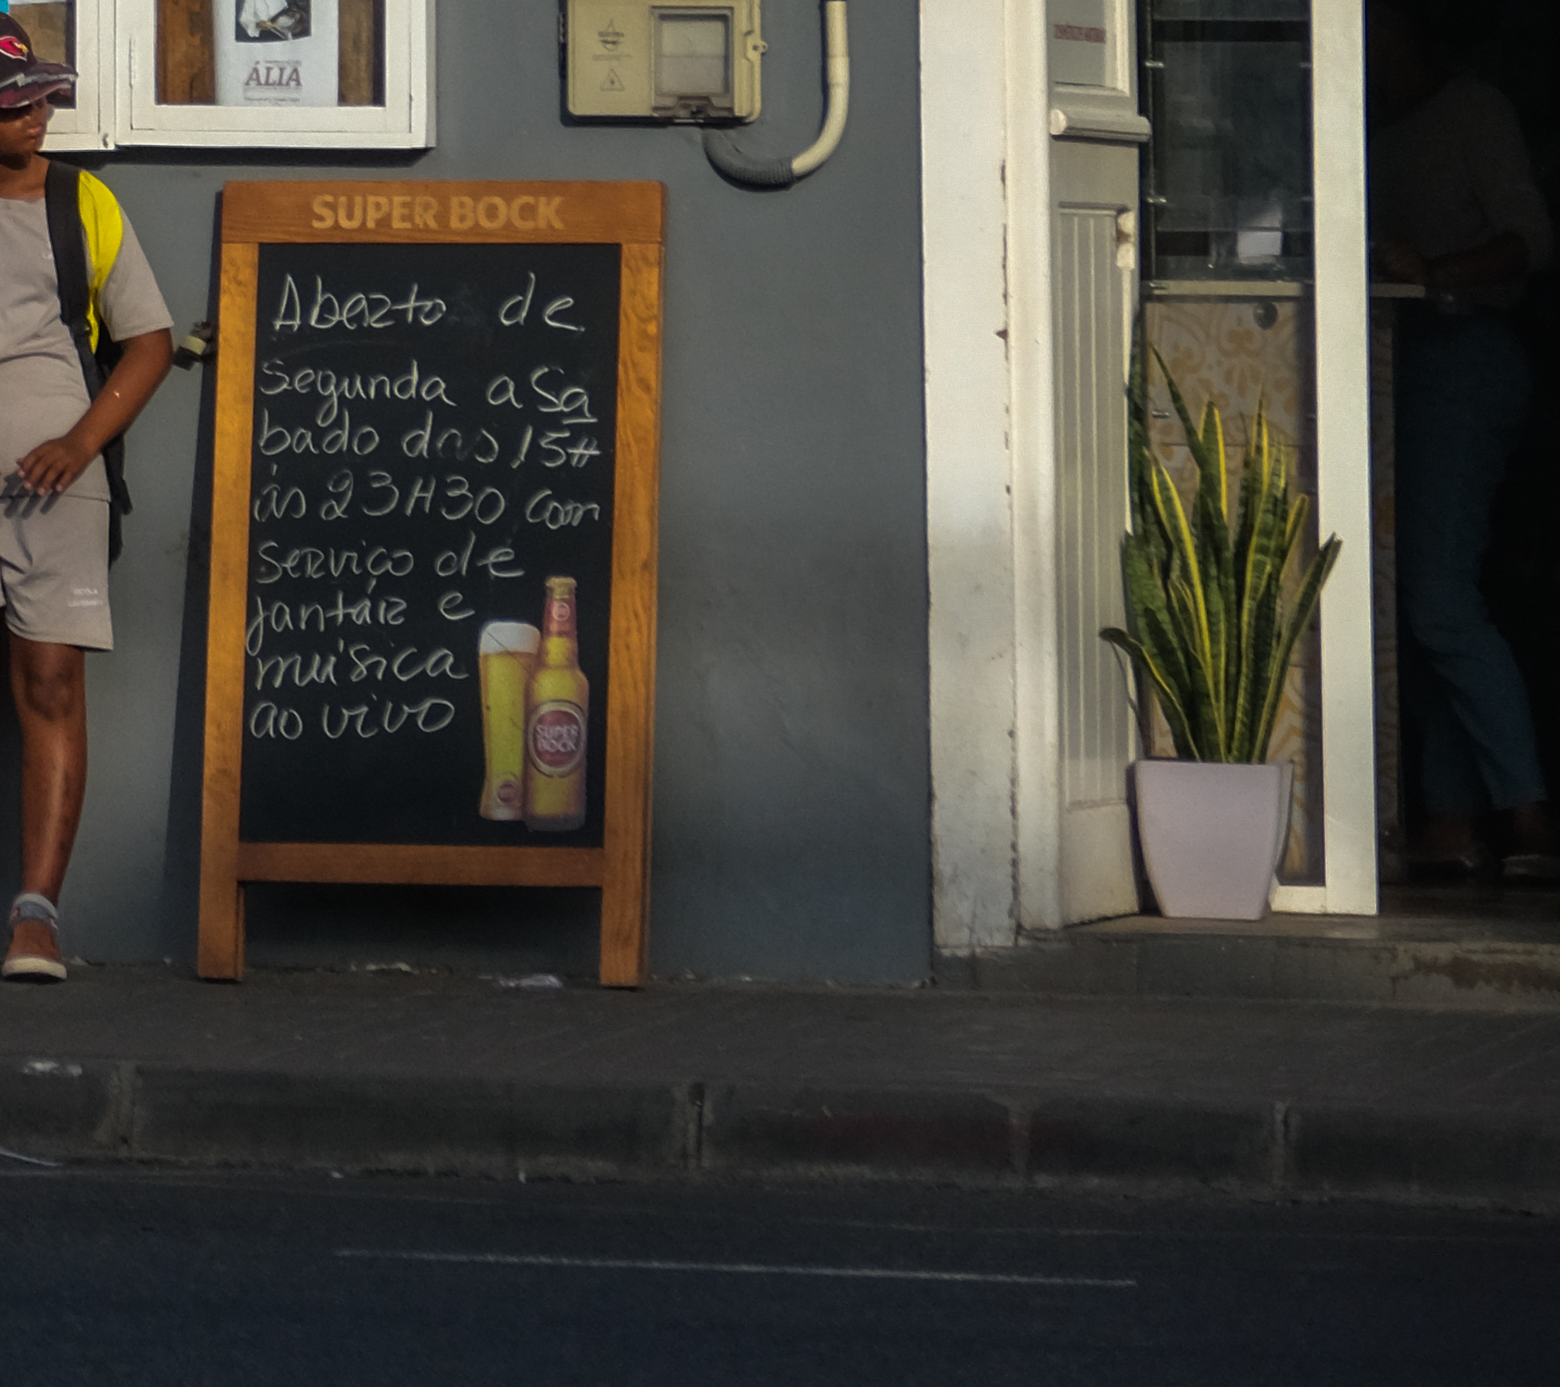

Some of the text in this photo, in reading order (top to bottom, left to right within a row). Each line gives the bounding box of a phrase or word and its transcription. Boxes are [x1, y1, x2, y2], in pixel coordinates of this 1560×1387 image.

[311, 194, 566, 230] SUPER BOCK
[499, 271, 586, 332] de
[487, 376, 523, 408] a
[259, 409, 380, 456] bado
[320, 470, 505, 525] 23H30
[435, 530, 524, 577] de
[440, 591, 476, 620] e
[250, 693, 456, 740] ao vivo
